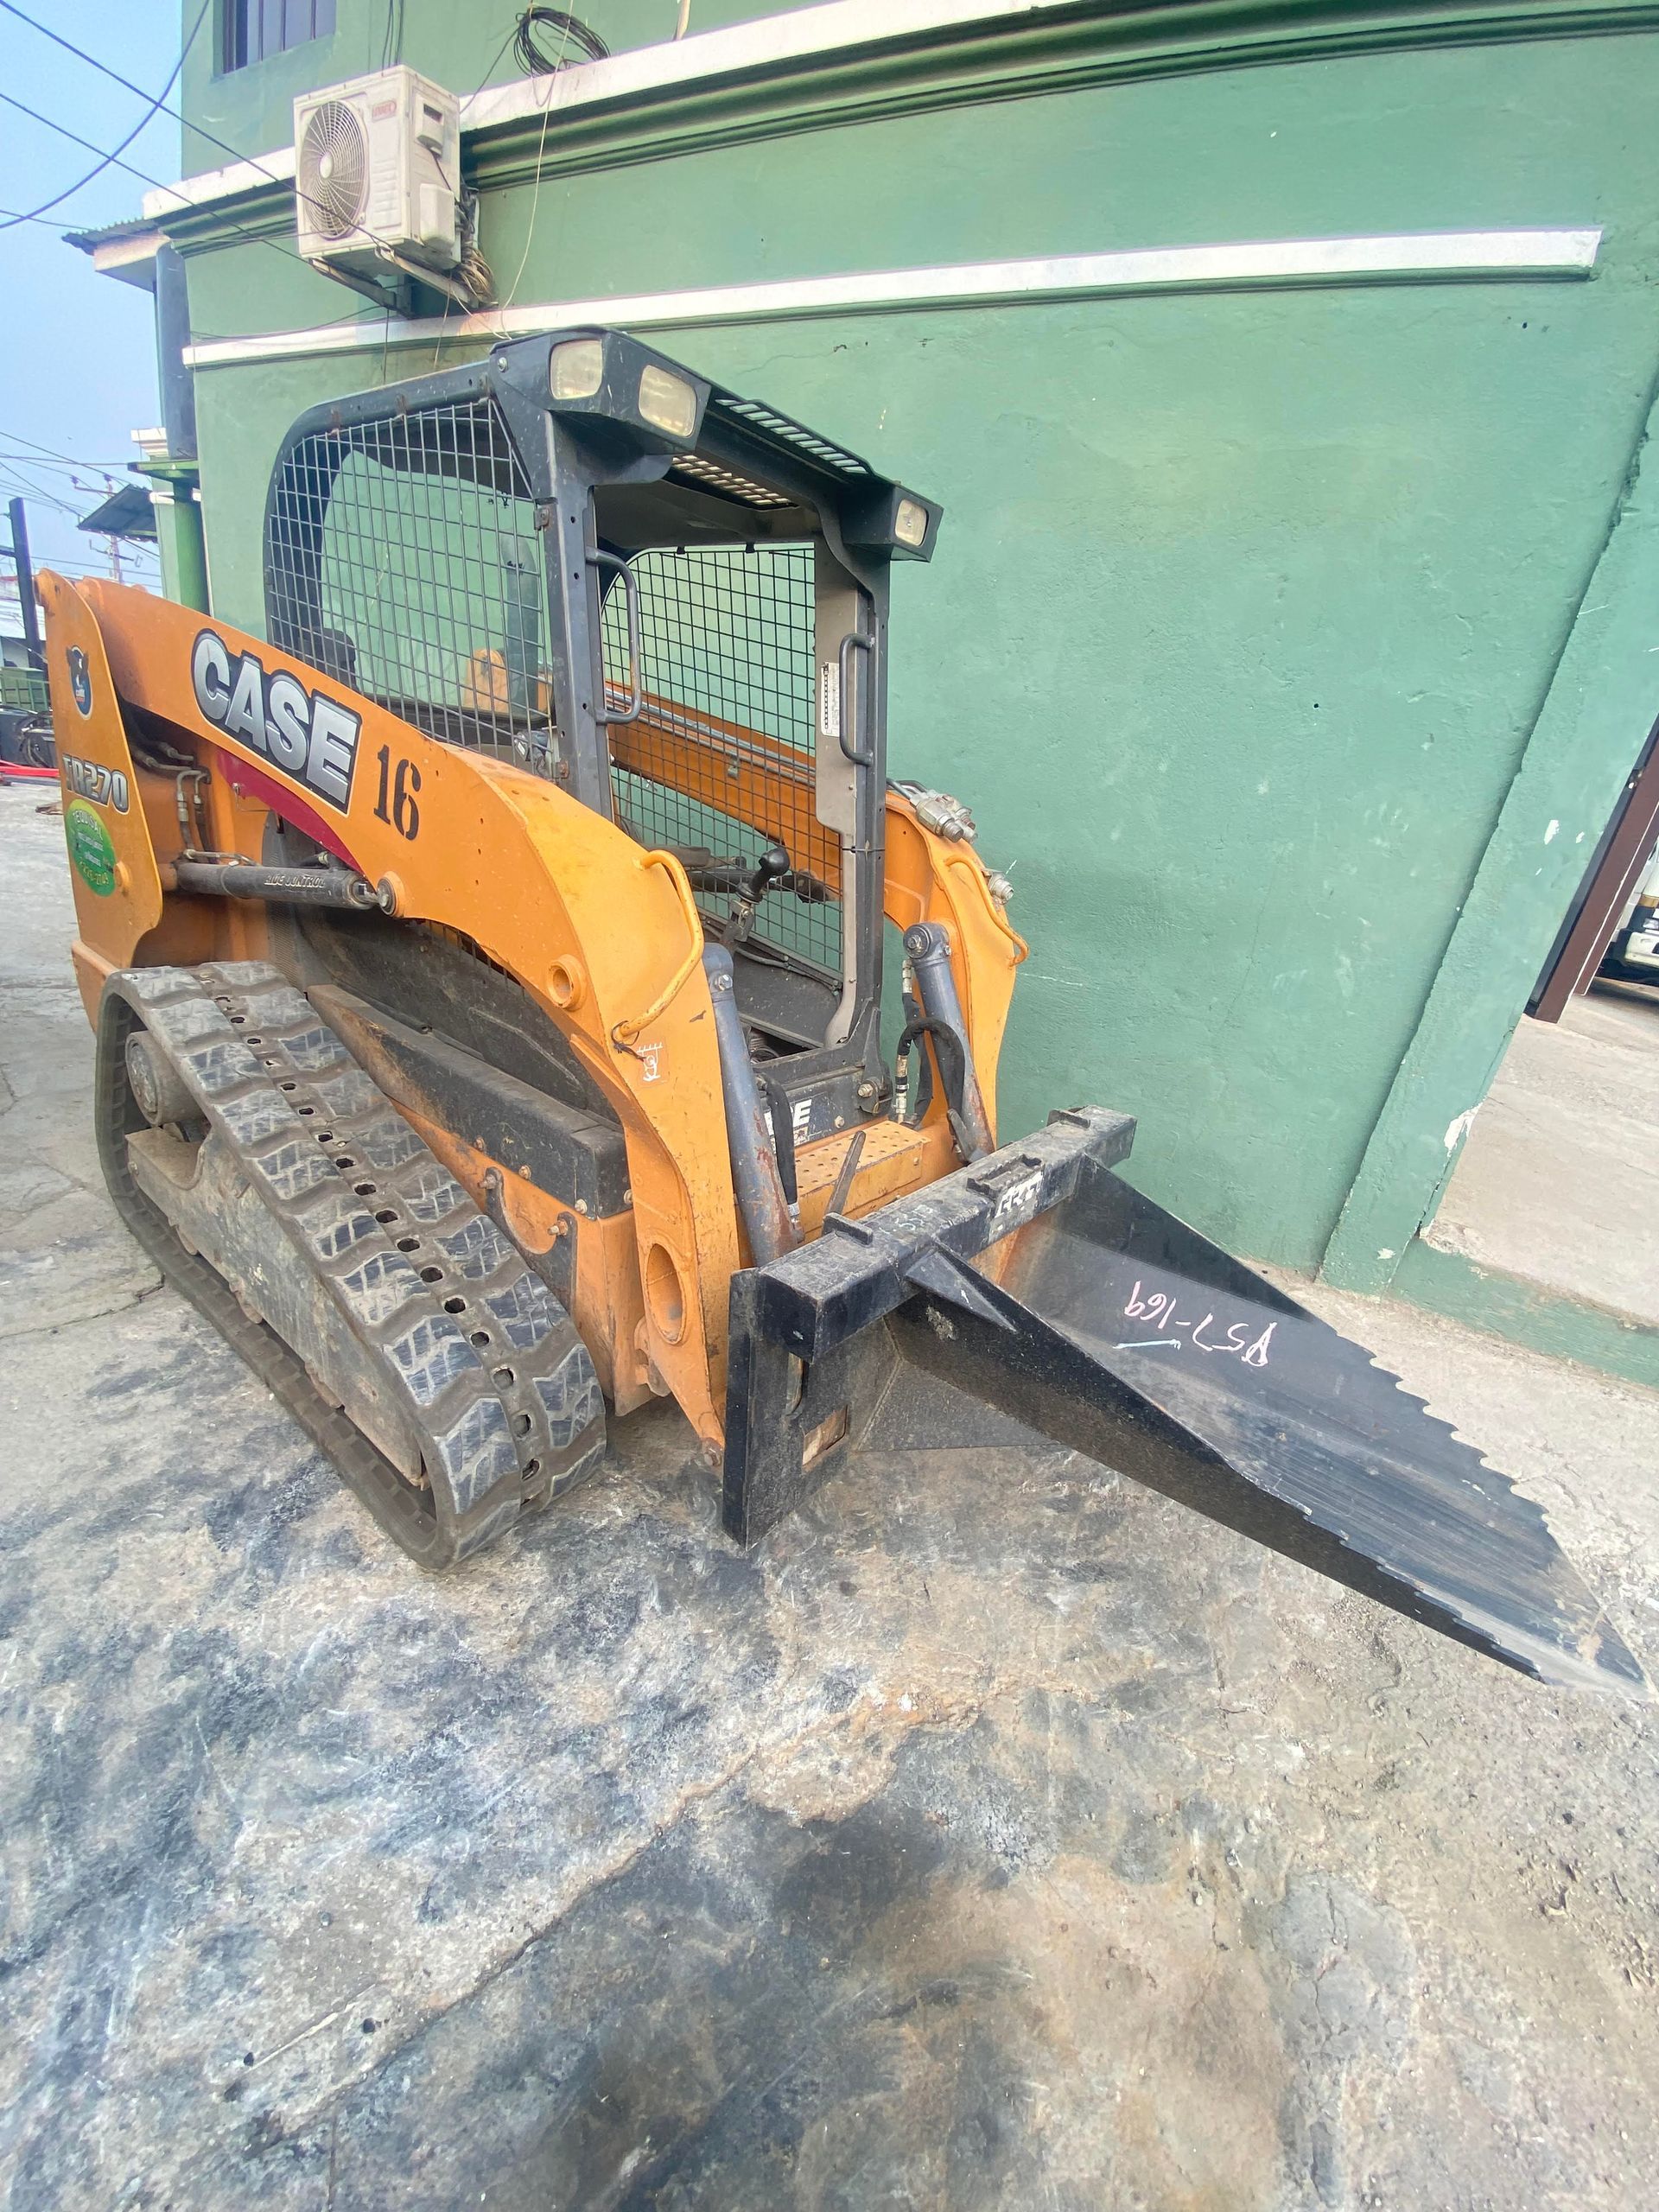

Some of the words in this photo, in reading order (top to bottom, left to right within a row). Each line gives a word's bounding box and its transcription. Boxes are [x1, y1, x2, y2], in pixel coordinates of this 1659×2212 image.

[192, 629, 361, 815] CASE
[63, 753, 129, 813] TR270
[374, 745, 421, 841] 16
